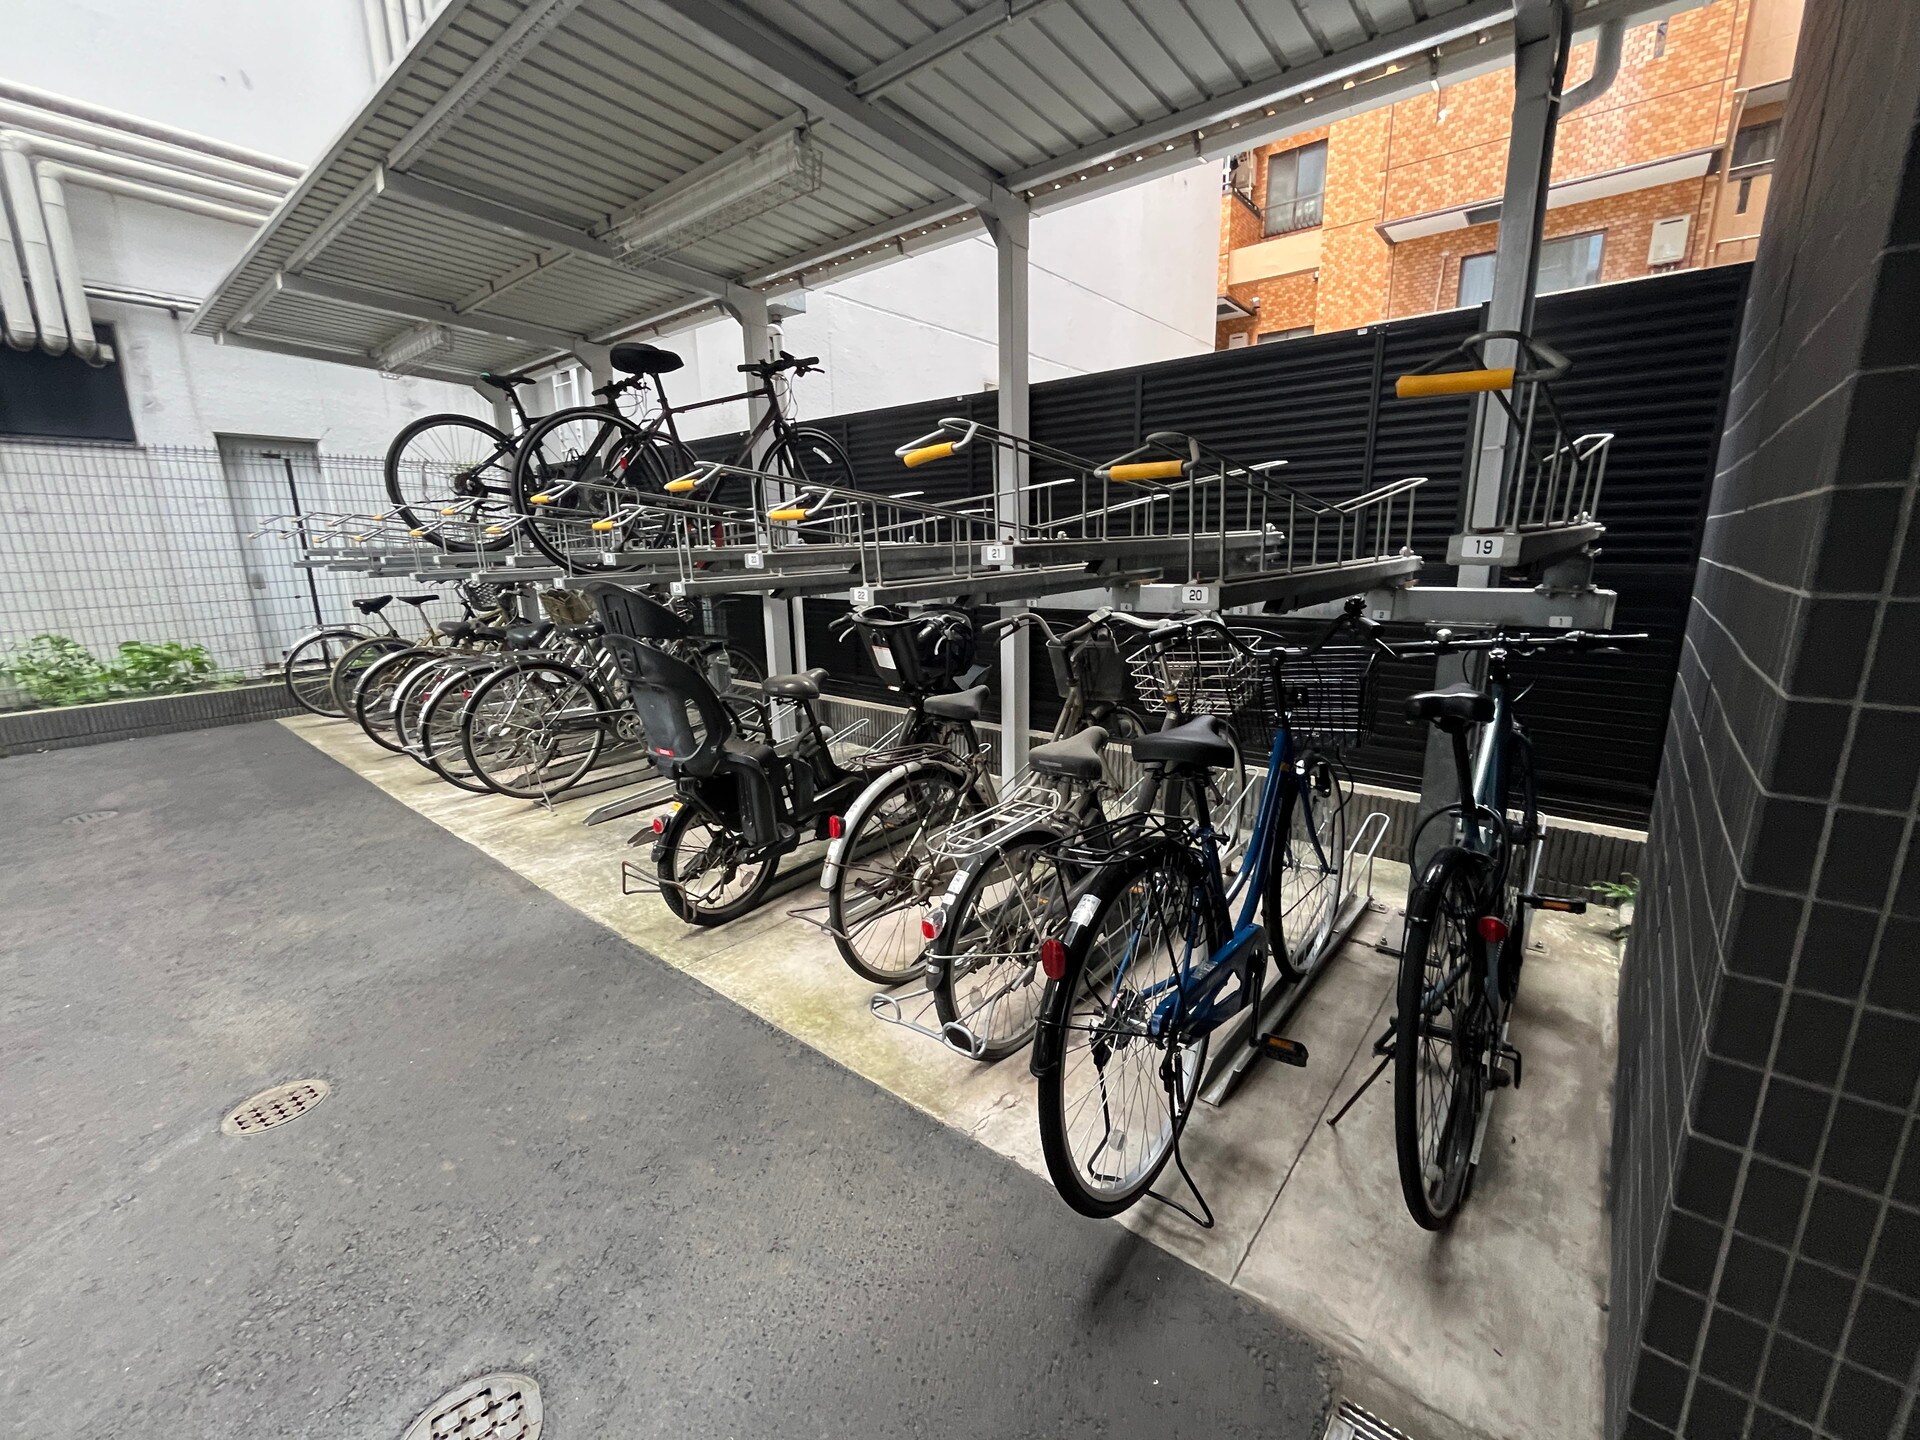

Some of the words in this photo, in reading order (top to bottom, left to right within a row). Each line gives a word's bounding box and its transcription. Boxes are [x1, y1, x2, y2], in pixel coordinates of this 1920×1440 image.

[1476, 540, 1493, 554] 19
[991, 548, 1001, 558] 21
[857, 590, 865, 600] 22
[1189, 589, 1202, 601] 20
[1379, 611, 1385, 619] 2
[1559, 617, 1563, 626] 1
